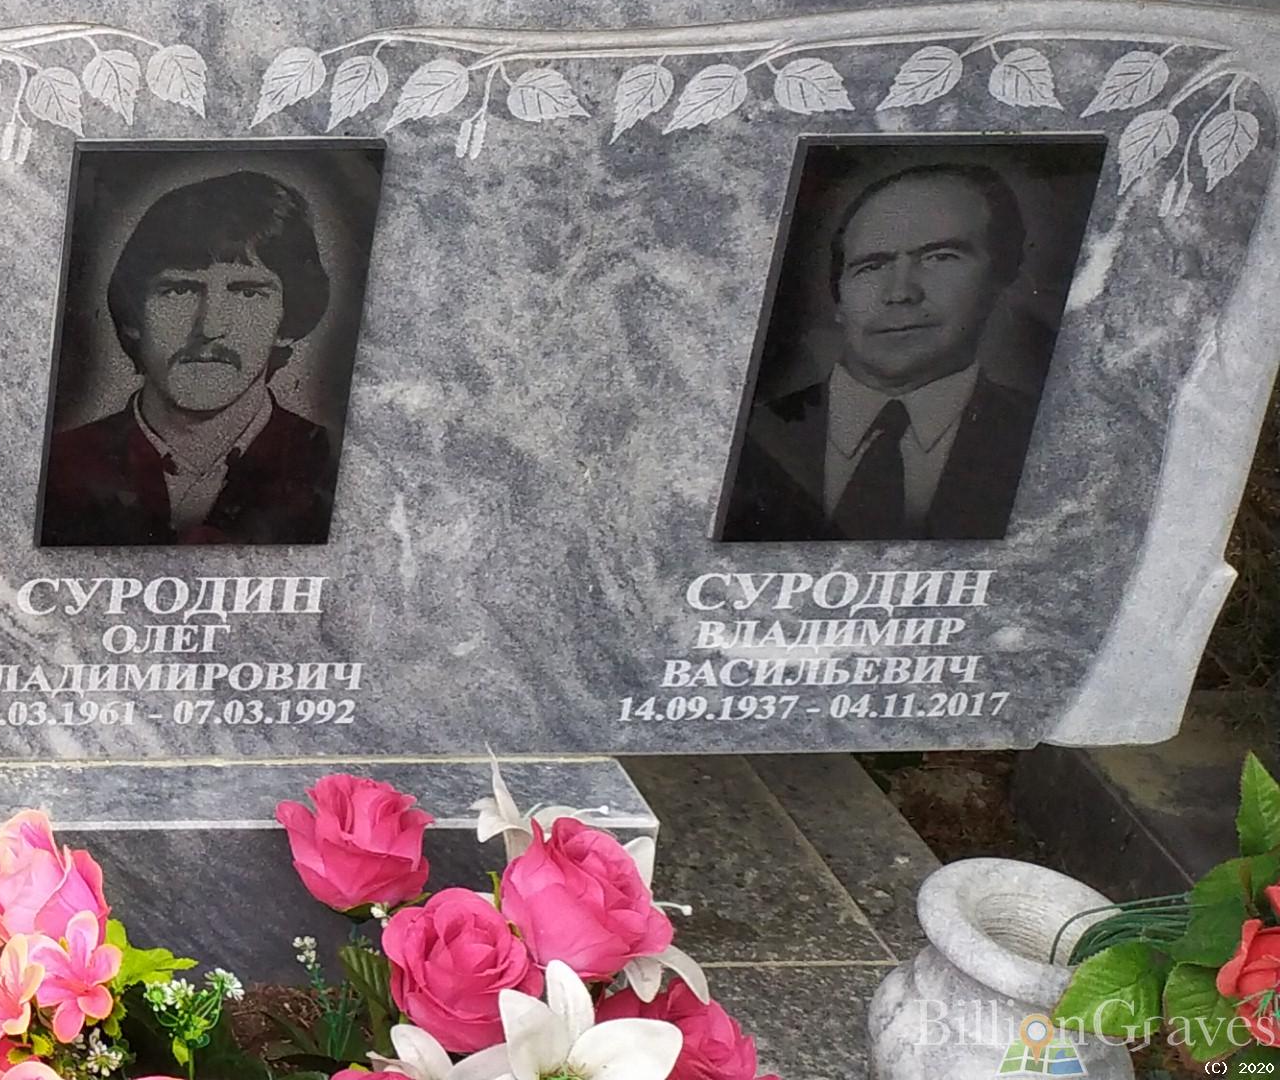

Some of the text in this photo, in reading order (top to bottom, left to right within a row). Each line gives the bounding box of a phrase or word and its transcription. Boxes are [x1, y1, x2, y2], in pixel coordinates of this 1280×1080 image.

[16, 576, 329, 624] СУРОДИН
[685, 570, 997, 617] СУРОДИН
[102, 624, 231, 655] ОЛЕГ
[692, 618, 966, 654] ВЛАДИМИР
[660, 655, 983, 688] ВАСИЛЬЕВИЧ
[173, 698, 356, 726] 07.03.1992
[616, 695, 800, 722] 14.09.1937
[829, 691, 1010, 719] 04.11.2017
